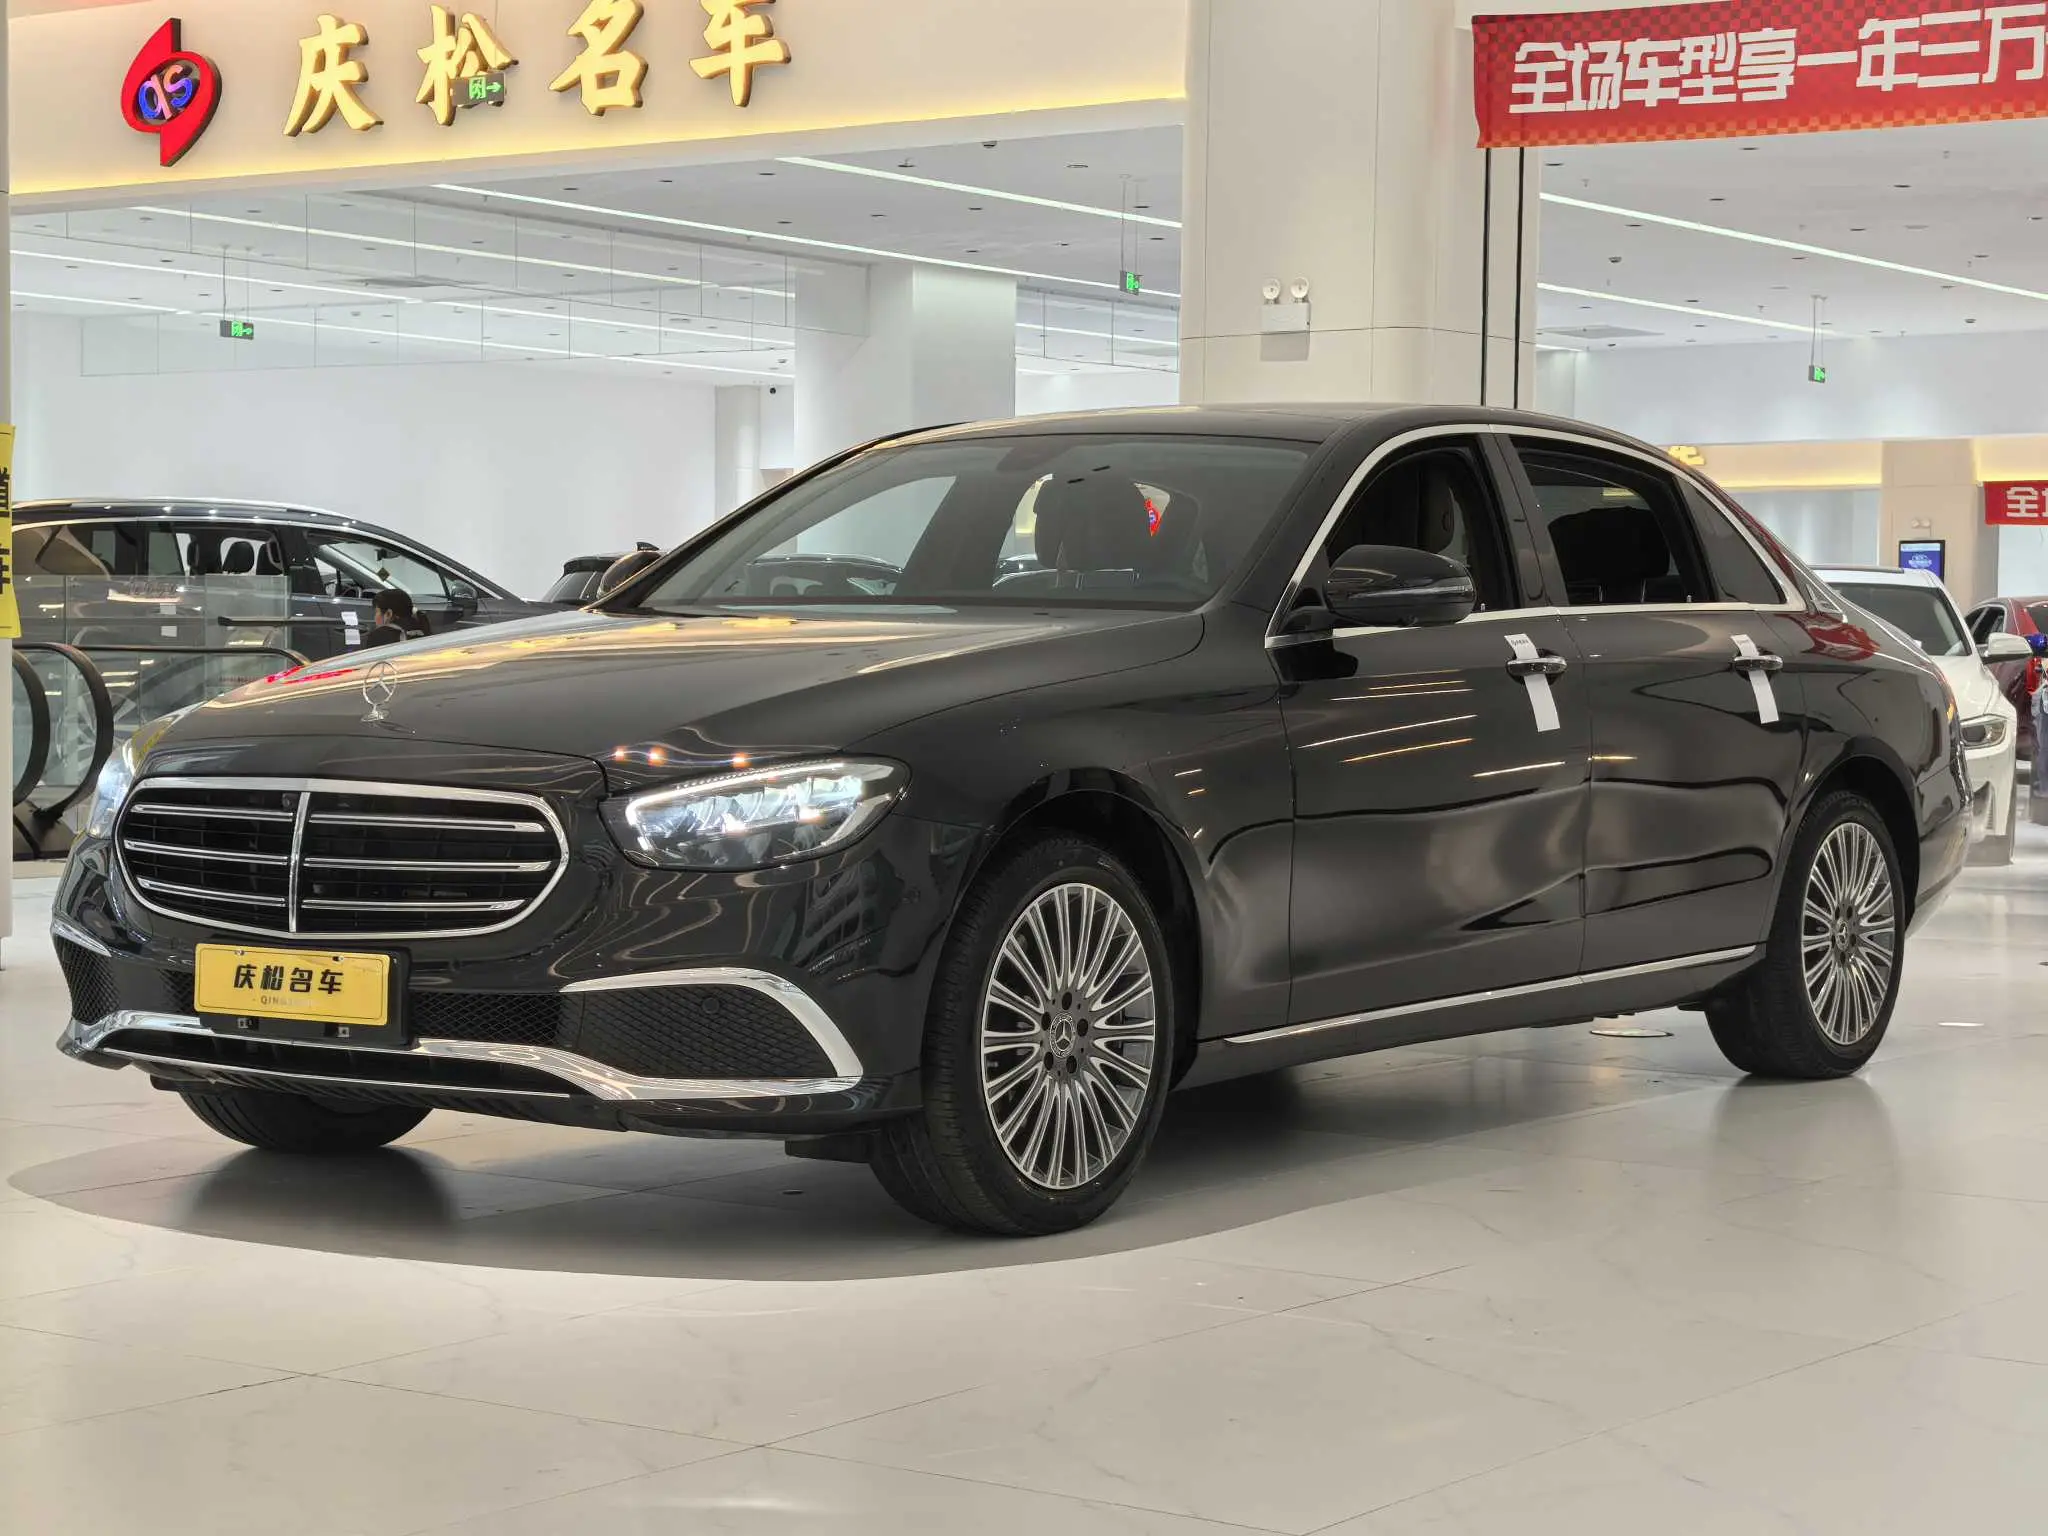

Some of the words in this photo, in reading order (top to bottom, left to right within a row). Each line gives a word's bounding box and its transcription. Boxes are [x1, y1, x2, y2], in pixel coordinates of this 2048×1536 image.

[283, 0, 792, 136] 庆松名车
[1509, 3, 2048, 113] 全场车型享一年三万
[2006, 486, 2048, 517] 全
[233, 964, 344, 995] 庆松名车
